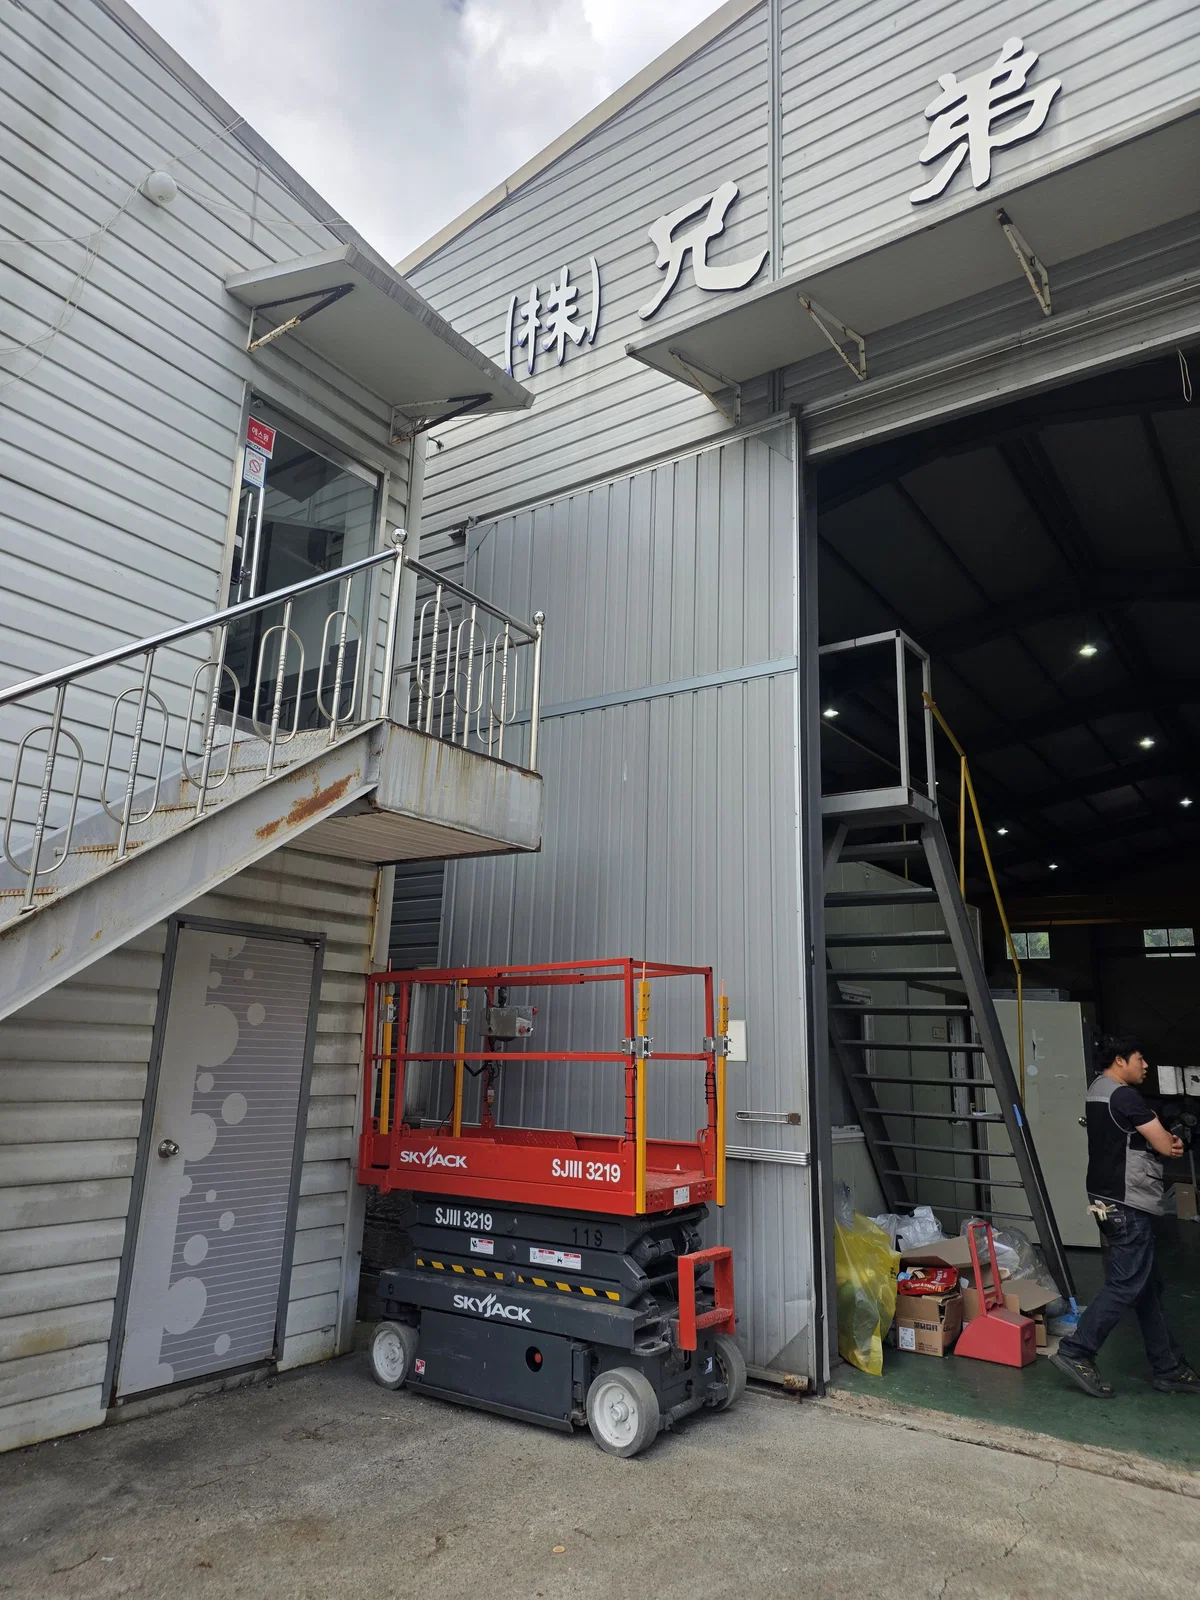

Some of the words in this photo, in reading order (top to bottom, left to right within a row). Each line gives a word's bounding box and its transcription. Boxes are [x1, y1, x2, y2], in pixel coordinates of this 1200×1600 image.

[400, 1146, 468, 1168] SKYJACK
[551, 1158, 583, 1179] SJIII
[585, 1161, 621, 1183] 3219
[435, 1207, 461, 1226] SJIII
[463, 1211, 493, 1231] 3219
[572, 1226, 603, 1248] 119
[453, 1293, 532, 1323] SKYJACK
